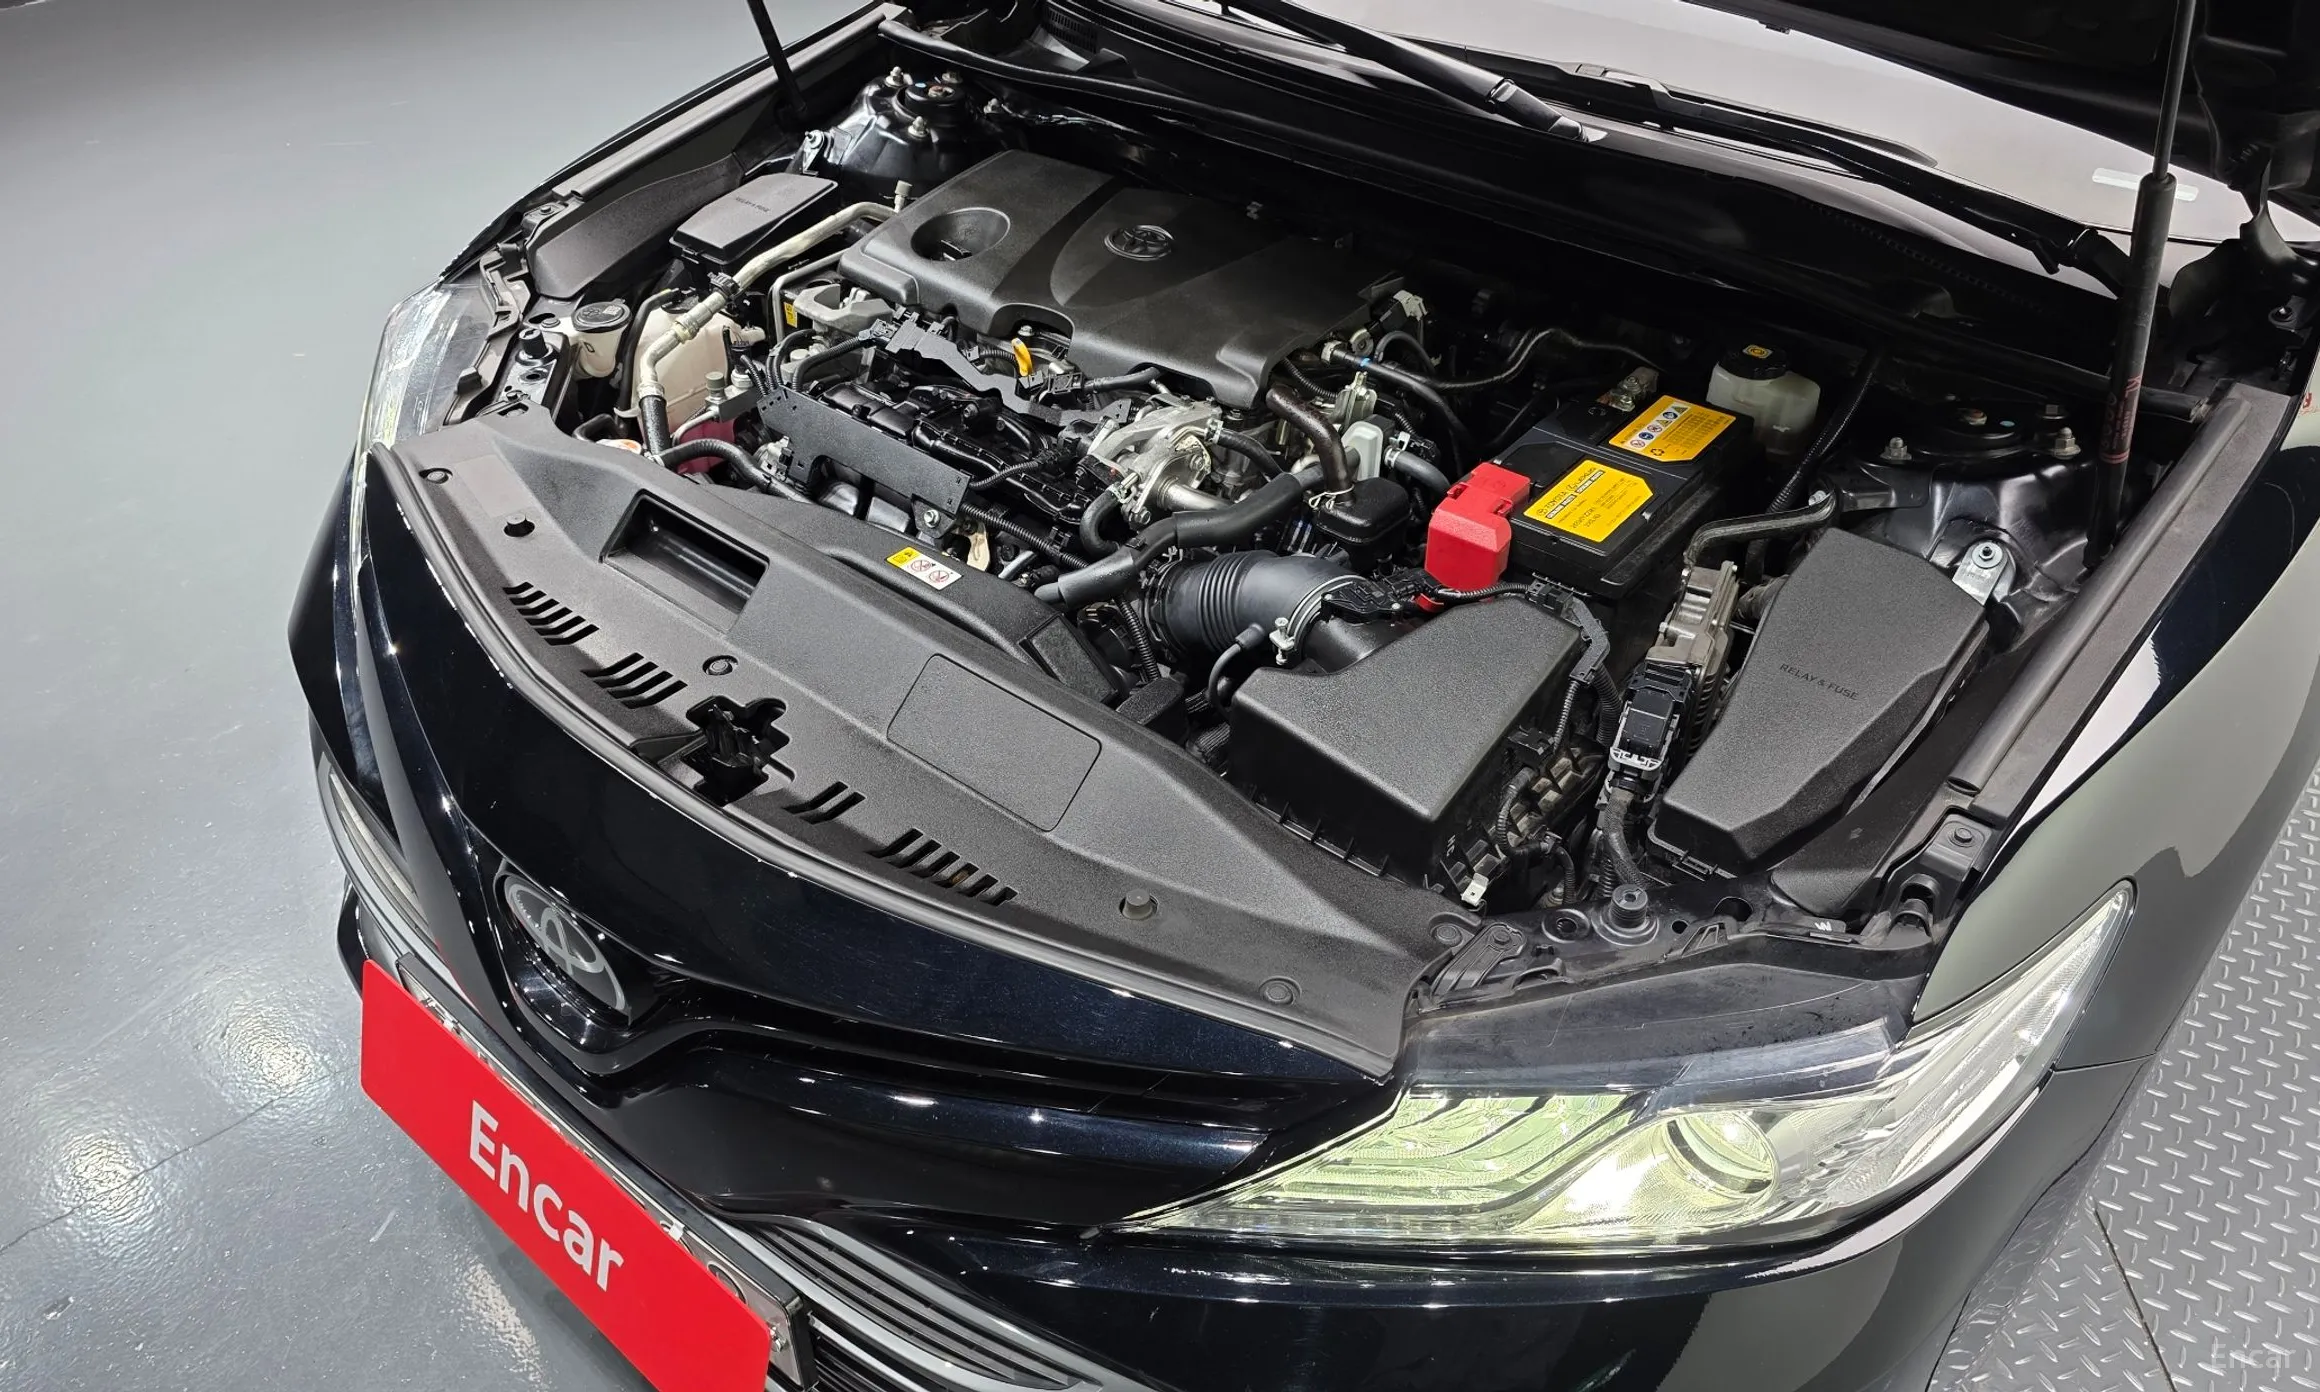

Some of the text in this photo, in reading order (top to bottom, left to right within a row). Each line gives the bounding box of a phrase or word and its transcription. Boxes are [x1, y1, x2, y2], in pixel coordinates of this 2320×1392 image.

[1780, 663, 1818, 682] RELAY
[1827, 683, 1860, 700] FUSE
[469, 1100, 624, 1292] Encar
